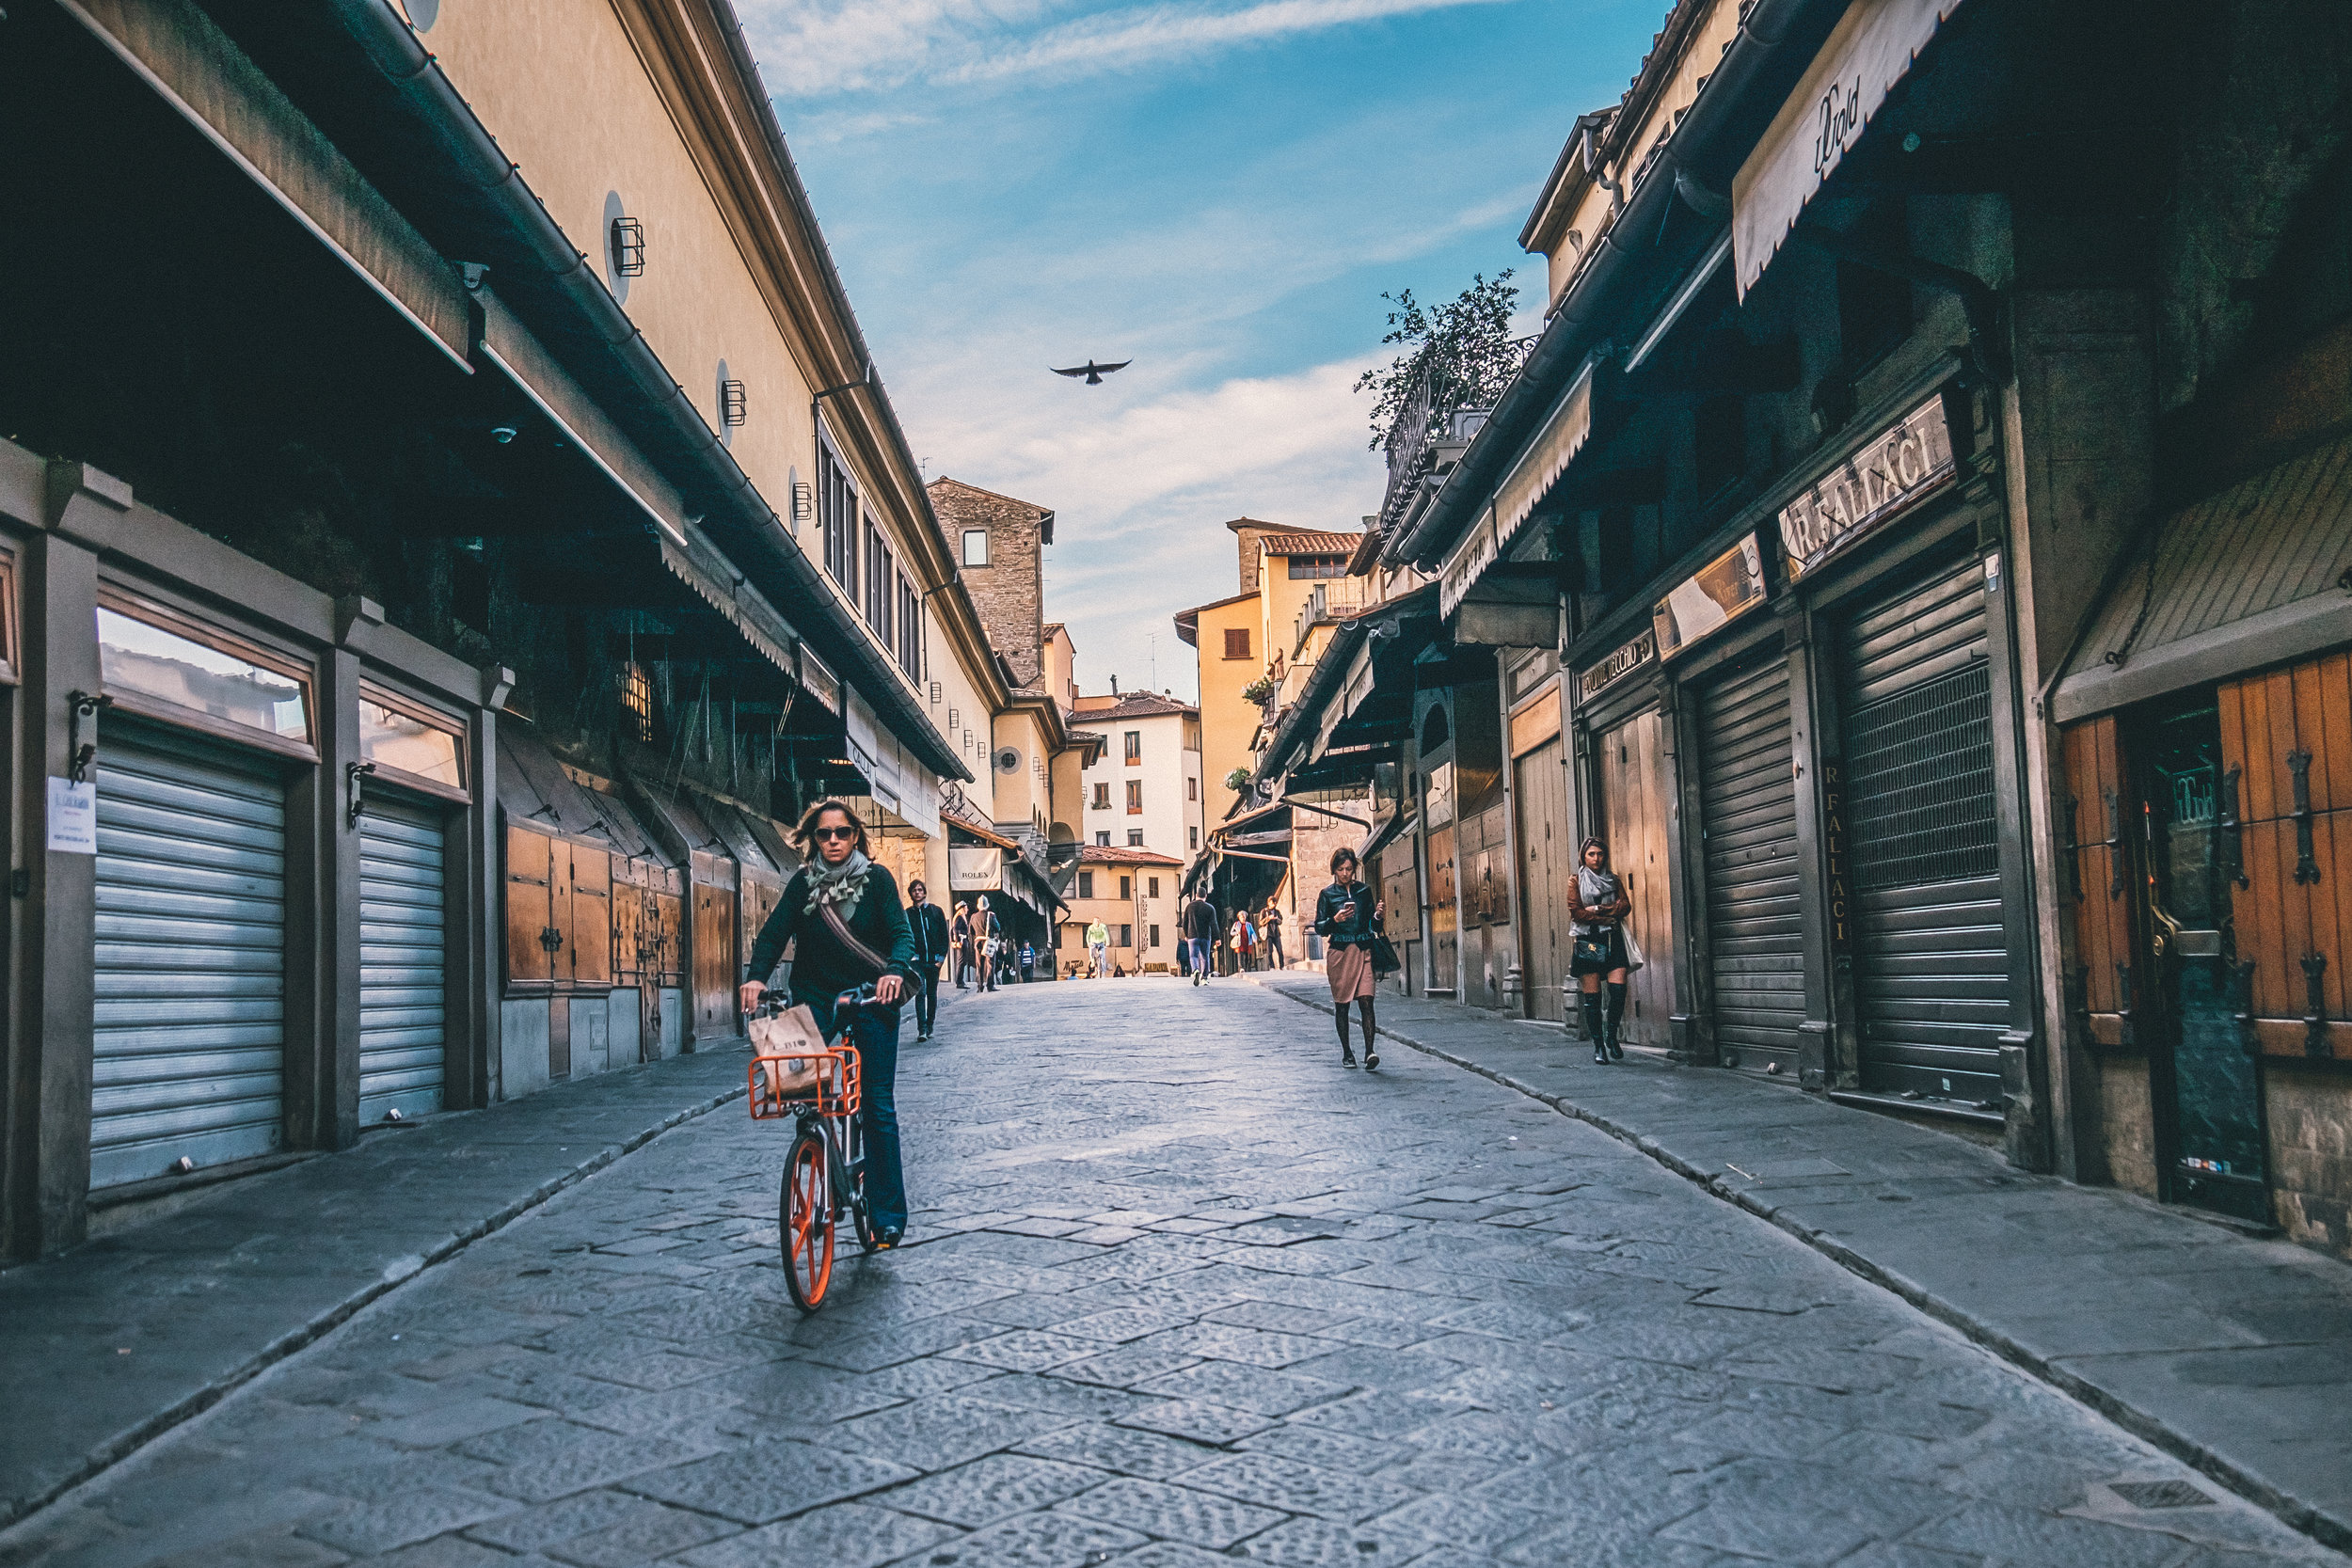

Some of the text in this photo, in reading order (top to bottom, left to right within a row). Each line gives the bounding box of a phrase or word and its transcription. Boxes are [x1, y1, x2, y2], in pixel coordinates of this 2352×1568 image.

[1815, 427, 1933, 543] FALLACI
[1608, 643, 1637, 678] VECCHIO
[961, 871, 990, 879] ROLEX
[1827, 793, 1845, 941] FALLACI
